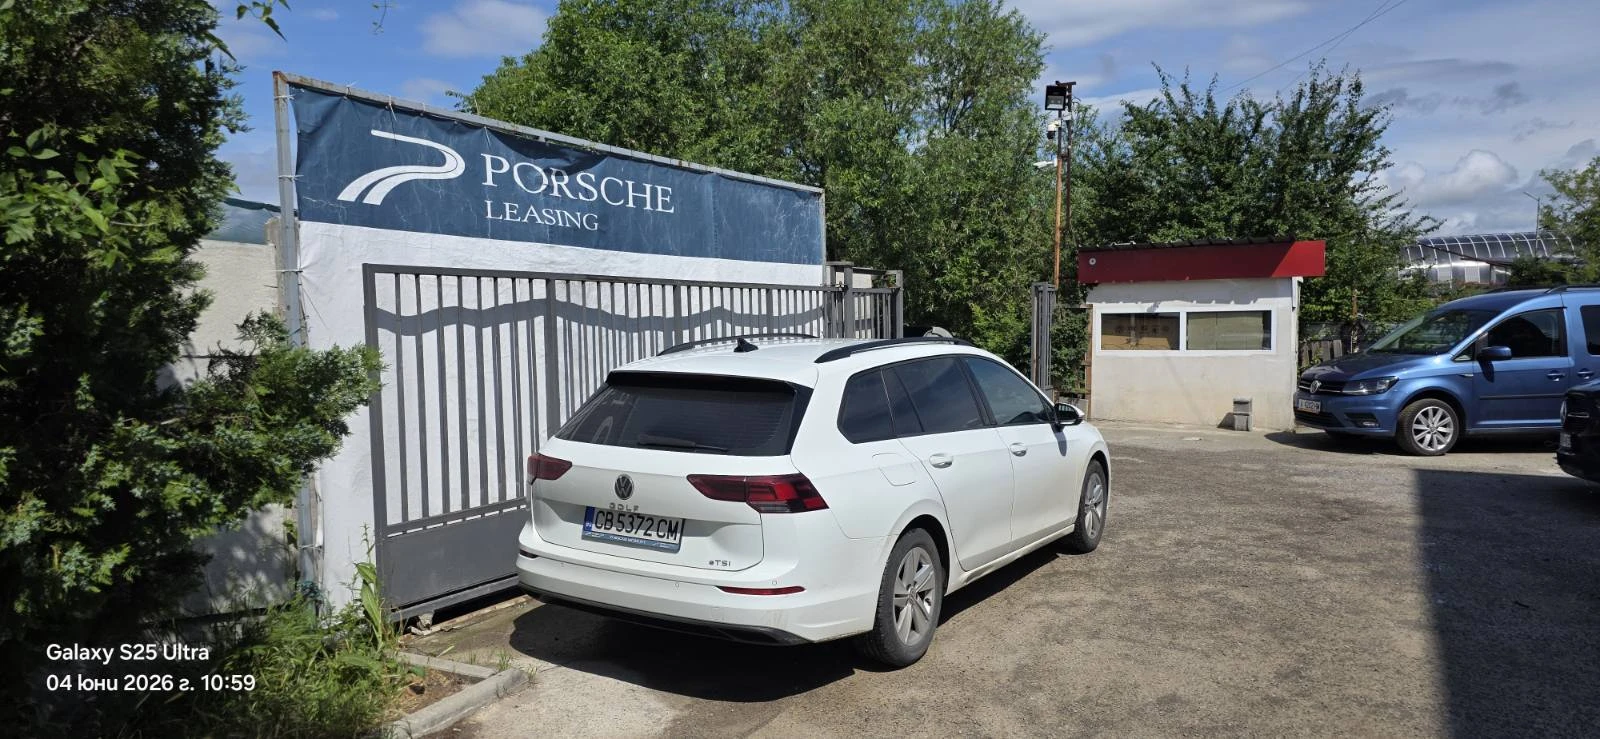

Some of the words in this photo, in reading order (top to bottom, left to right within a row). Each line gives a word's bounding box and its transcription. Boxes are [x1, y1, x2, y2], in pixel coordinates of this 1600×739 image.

[481, 154, 675, 213] PORSCHE
[485, 200, 599, 231] LEASING
[594, 510, 613, 530] CB
[616, 512, 655, 537] 5372
[656, 519, 679, 540] CM
